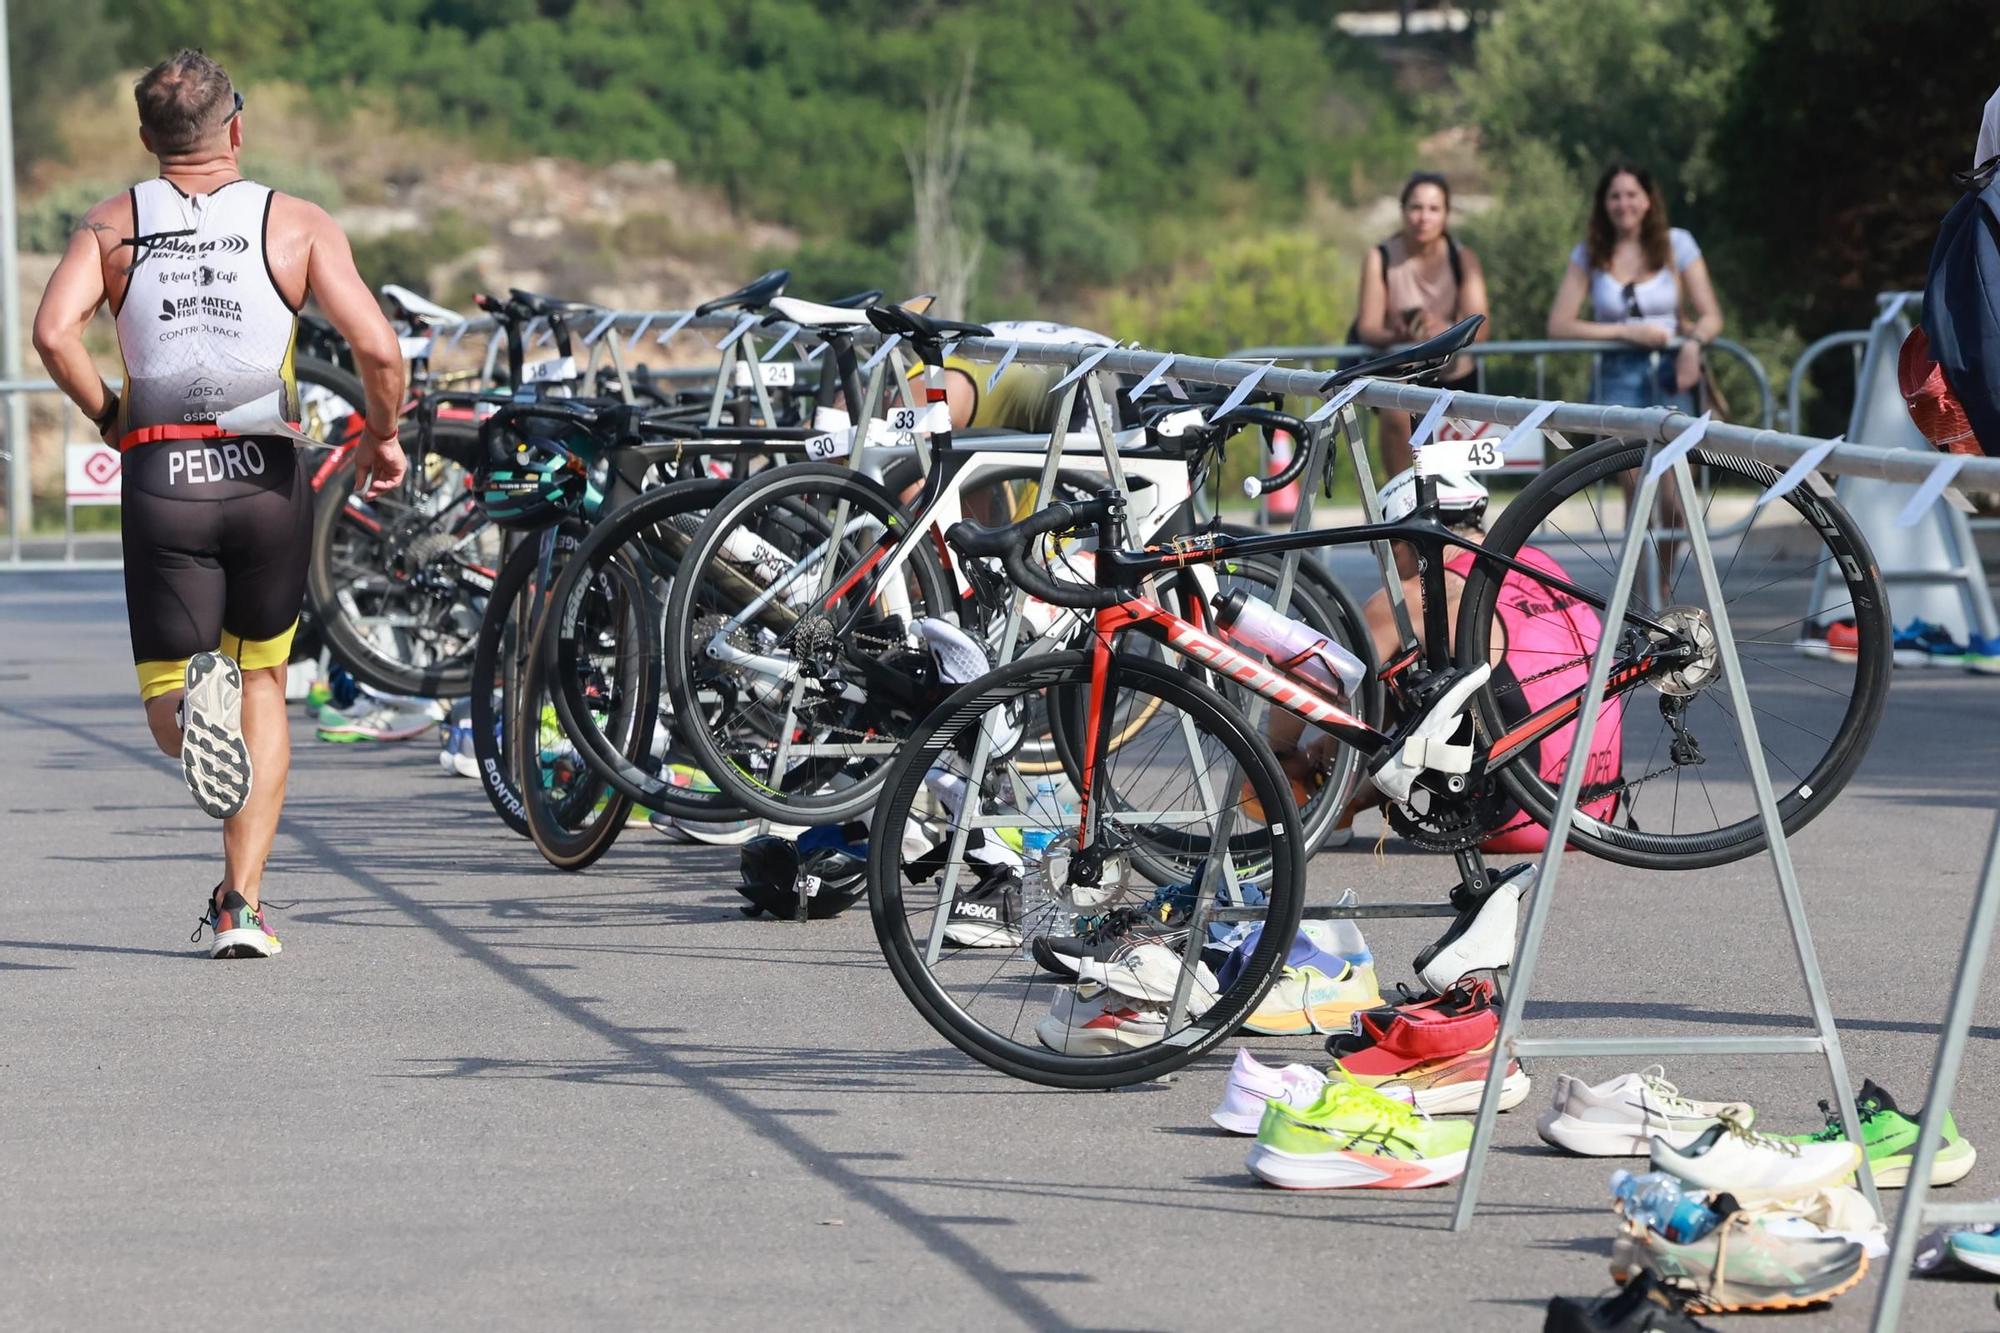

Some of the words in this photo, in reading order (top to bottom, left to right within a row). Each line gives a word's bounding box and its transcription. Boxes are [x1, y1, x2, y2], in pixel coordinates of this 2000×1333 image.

[187, 253, 208, 261] CR
[216, 271, 238, 284] Café
[177, 296, 242, 313] FARMATECA
[530, 364, 548, 378] 18
[768, 366, 788, 382] 24
[895, 410, 915, 429] 33
[813, 437, 835, 457] 30
[1467, 442, 1496, 466] 43
[168, 440, 265, 485] PEDRO
[484, 757, 527, 821] BONTRA
[954, 901, 998, 920] HOKA
